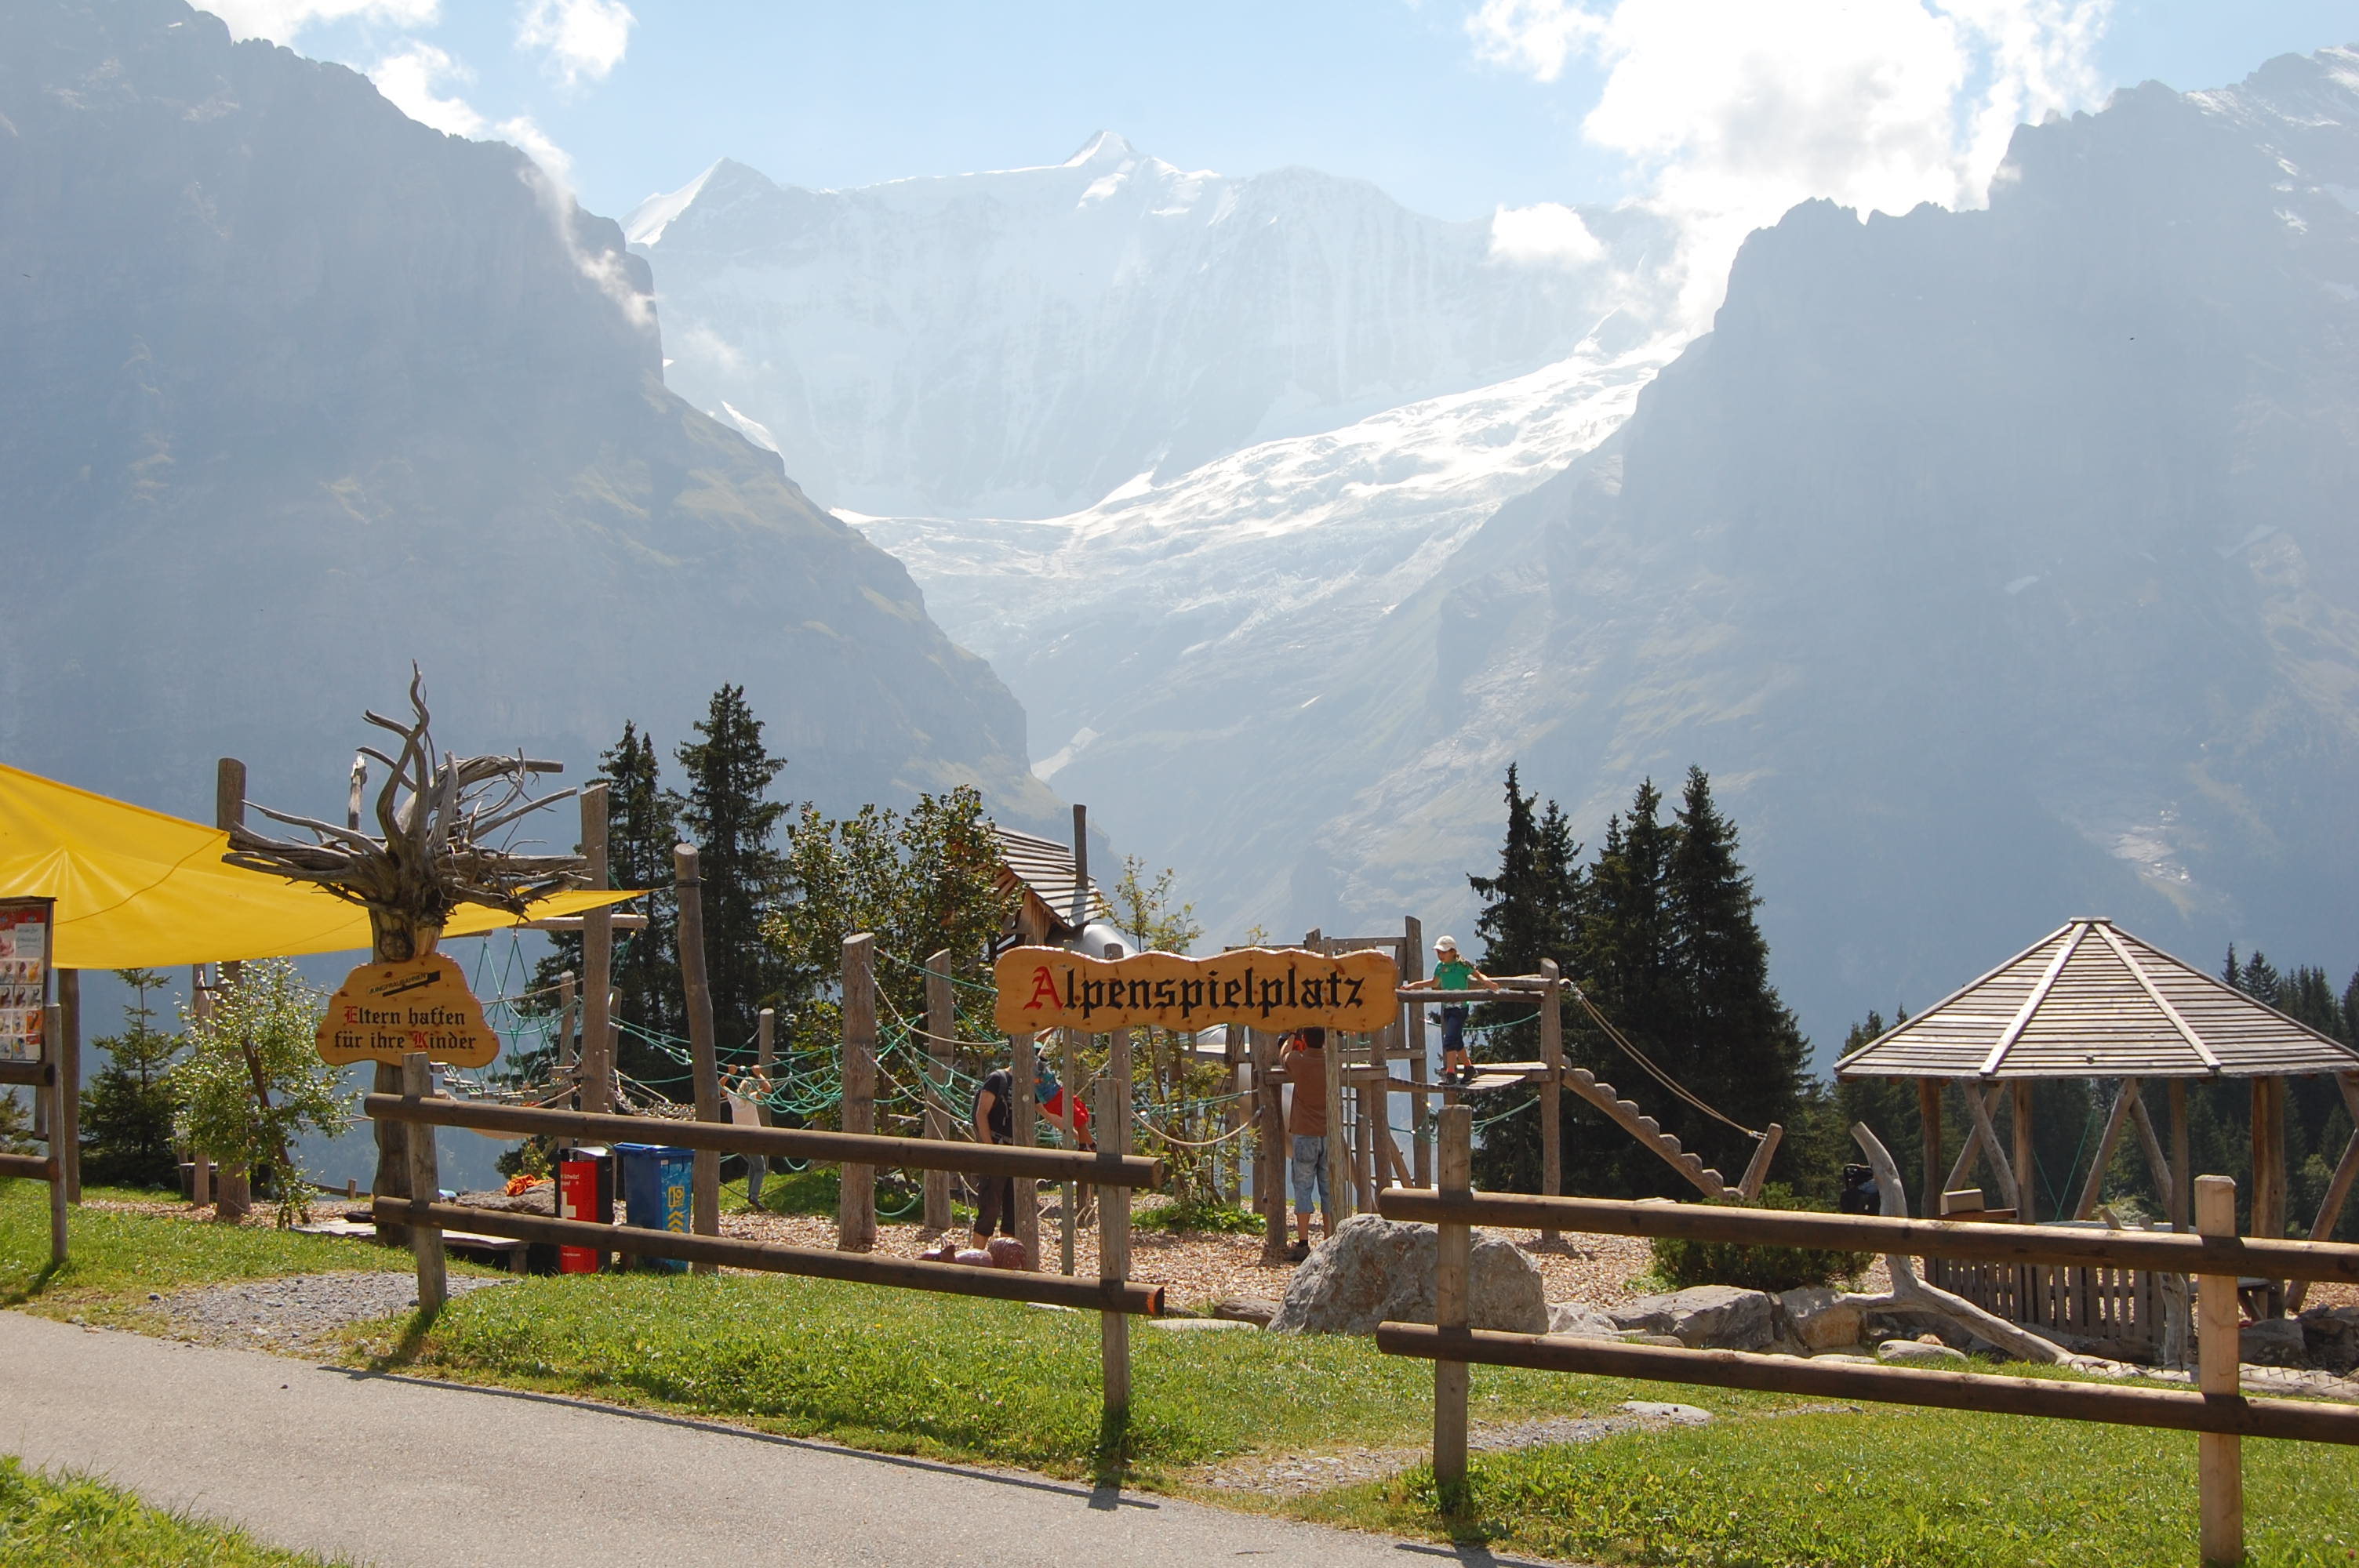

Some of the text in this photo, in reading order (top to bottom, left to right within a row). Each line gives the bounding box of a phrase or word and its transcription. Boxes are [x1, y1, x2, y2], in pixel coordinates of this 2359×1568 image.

[369, 972, 427, 994] JUNGFRAUBAHNEN
[1023, 965, 1365, 1020] Alpenspielplatz
[343, 1005, 465, 1027] Eltern haften
[334, 1030, 477, 1049] für ihre Kinder
